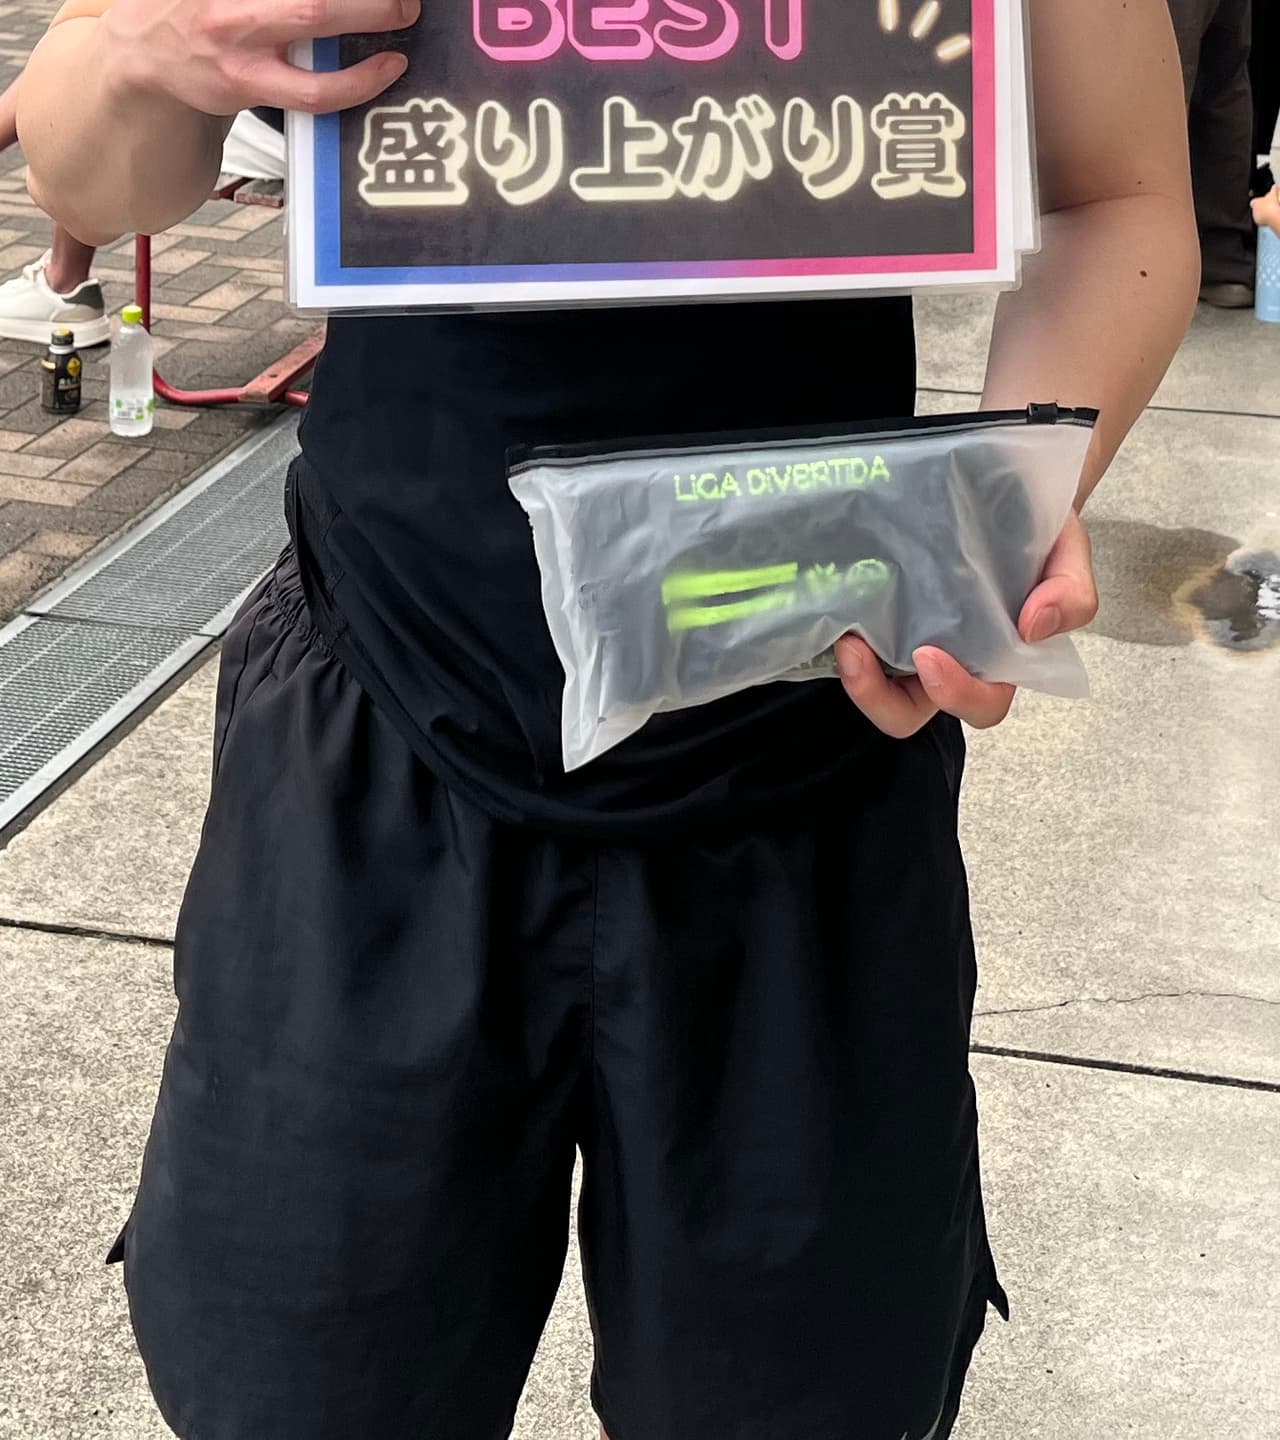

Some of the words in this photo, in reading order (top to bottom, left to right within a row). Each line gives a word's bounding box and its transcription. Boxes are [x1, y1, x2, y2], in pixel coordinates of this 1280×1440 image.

[357, 92, 967, 206] 盛り上がり賞
